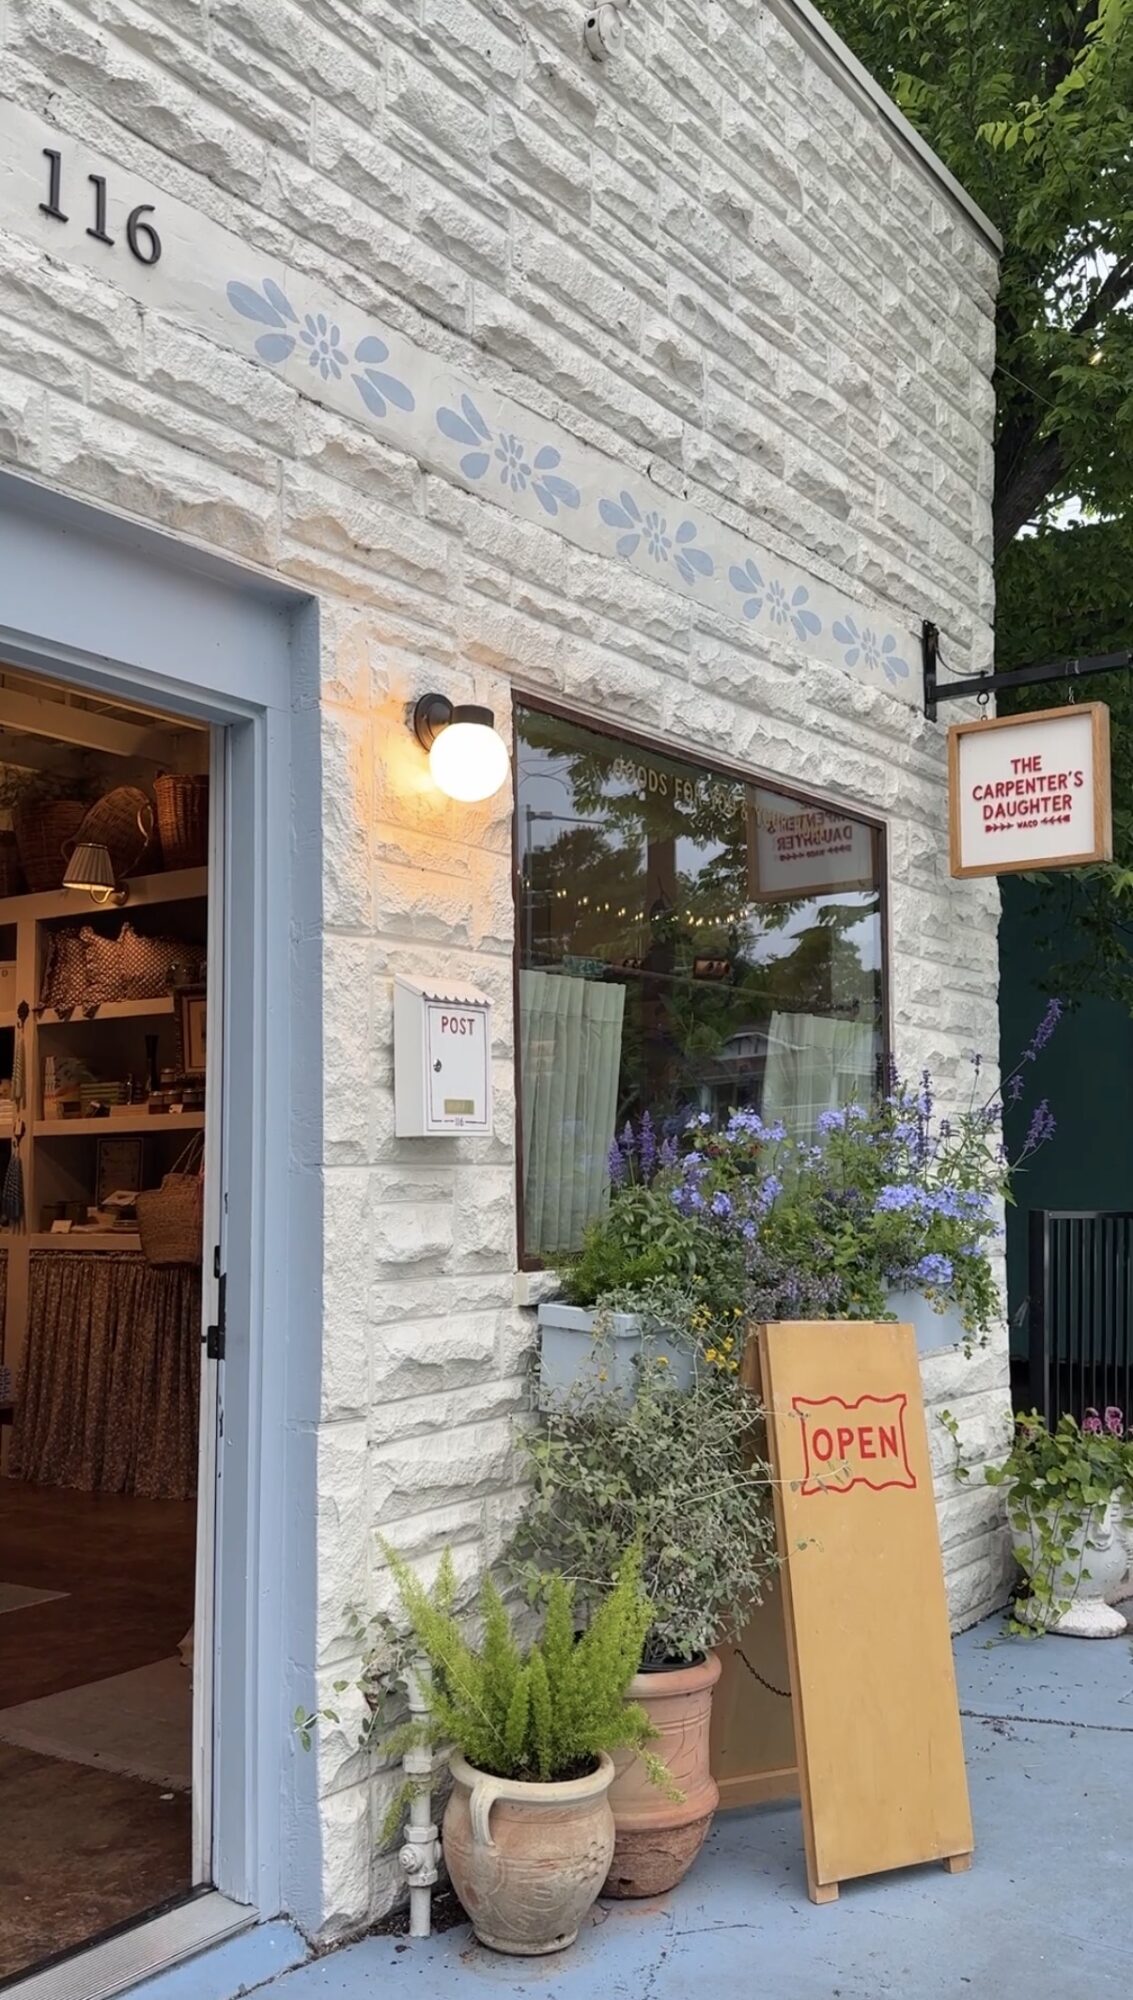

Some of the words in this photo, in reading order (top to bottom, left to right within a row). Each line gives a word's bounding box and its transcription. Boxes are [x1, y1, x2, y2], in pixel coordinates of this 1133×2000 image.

[39, 148, 162, 265] 116
[1010, 755, 1042, 775] THE
[972, 771, 1084, 801] CARPENTER'S
[983, 794, 1073, 821] DAUGHTER
[1016, 819, 1039, 830] WACO
[441, 1015, 476, 1036] POST
[812, 1425, 899, 1461] OPEN
